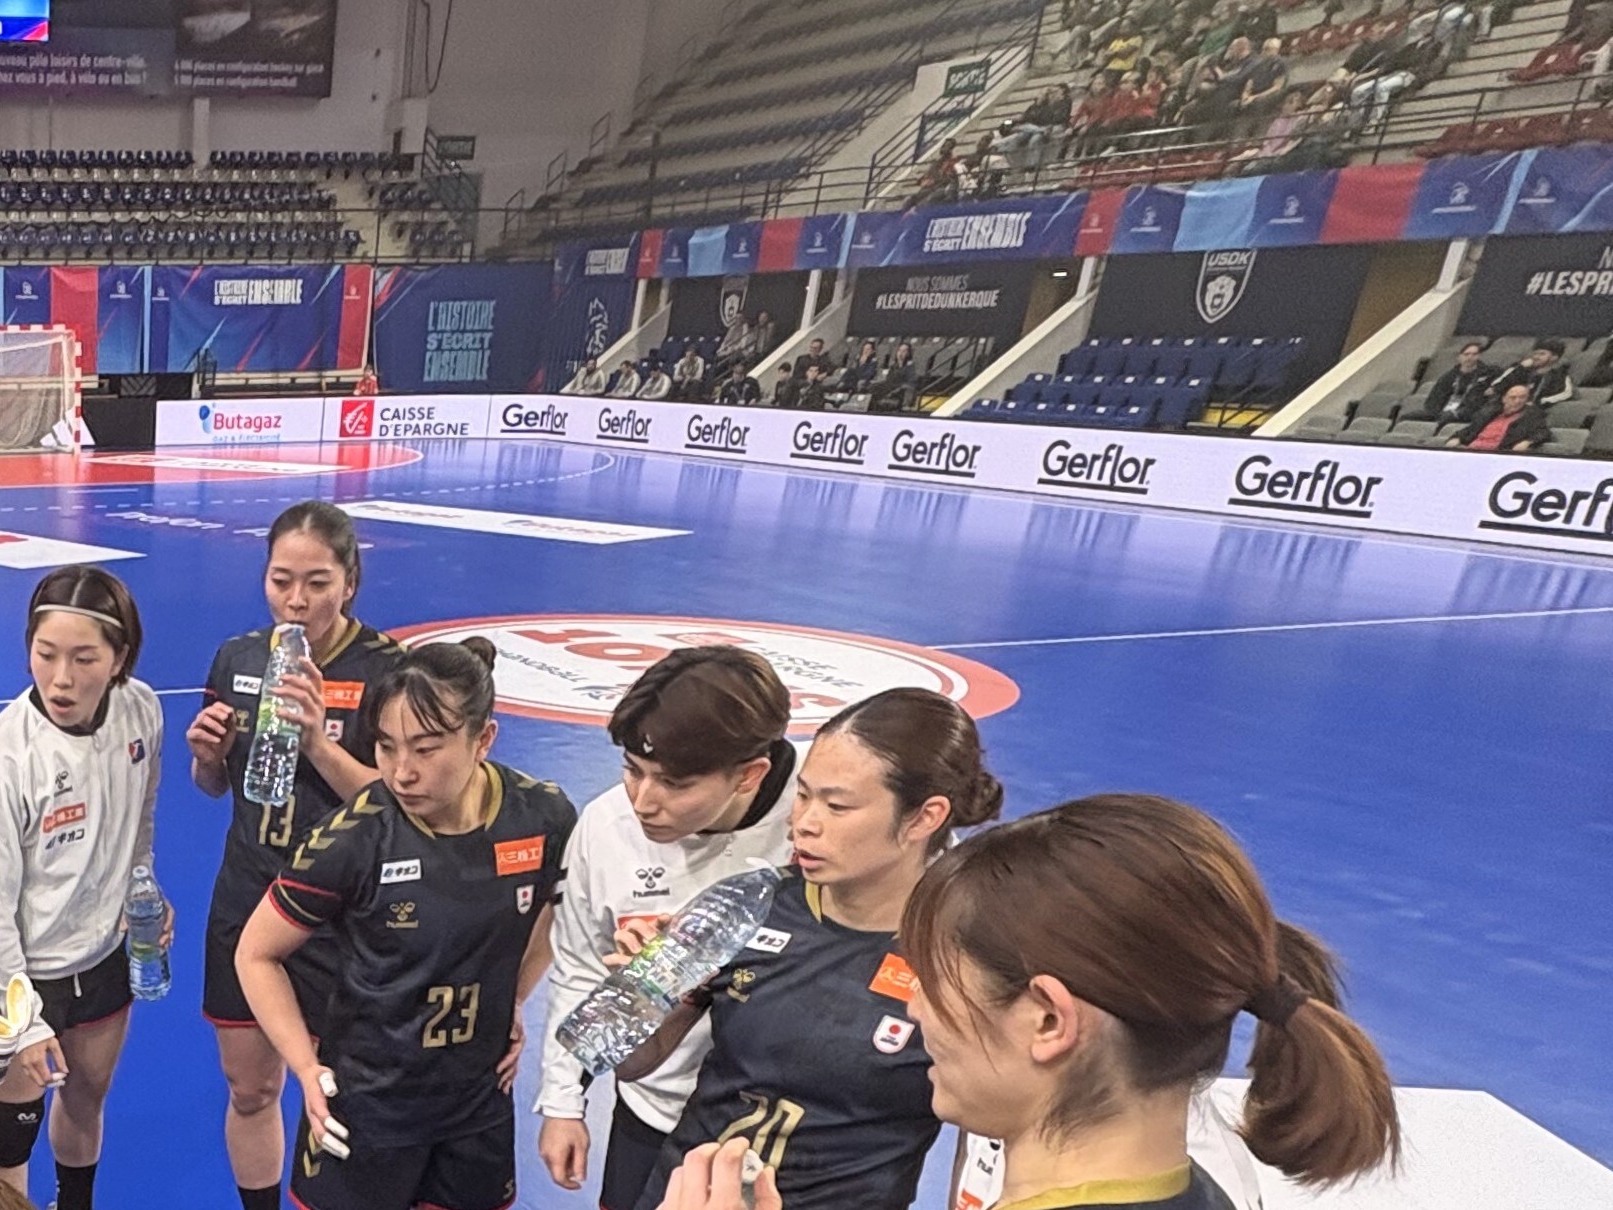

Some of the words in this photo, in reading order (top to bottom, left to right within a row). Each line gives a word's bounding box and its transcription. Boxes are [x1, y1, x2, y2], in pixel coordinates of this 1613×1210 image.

[1206, 251, 1251, 267] USDK
[875, 289, 1000, 309] #LESPRITDEDUNKERQUE
[428, 300, 496, 331] L'HISTOIRE
[213, 412, 282, 432] Butagaz
[379, 406, 436, 422] CAISSE
[502, 403, 568, 431] Gerflor
[598, 407, 652, 440] Gerflor
[379, 423, 470, 437] D'EPARGNE
[687, 414, 750, 448] Gerflor
[793, 420, 869, 459] Gerflor
[891, 429, 982, 472] Gerflor
[1042, 439, 1157, 488] Gerflor
[1234, 455, 1384, 510] Gerflor
[633, 888, 670, 898] hummel
[422, 982, 481, 1048] 23
